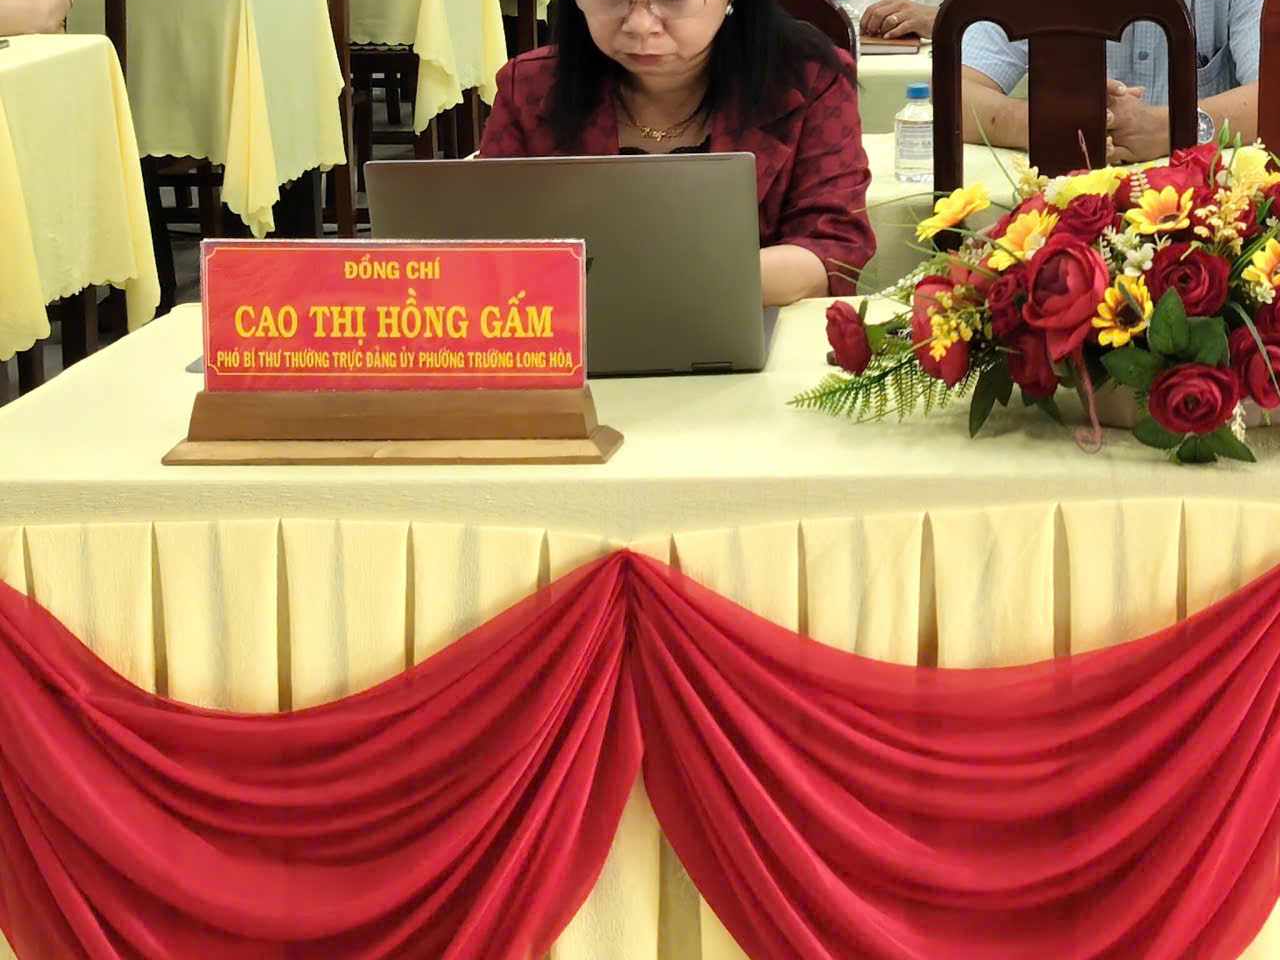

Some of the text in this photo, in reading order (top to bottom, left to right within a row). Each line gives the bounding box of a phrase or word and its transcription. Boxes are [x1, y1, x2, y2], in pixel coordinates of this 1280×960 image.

[344, 253, 440, 280] ĐỒNG CHÍ
[234, 287, 554, 346] CAO THỊ HỒNG GẤM
[216, 345, 573, 371] PHÓ BÍ THƯ THƯỜNG TRỰC ĐẢNG ỦY PHƯỜNG TRƯỜNG LONG HÒA
